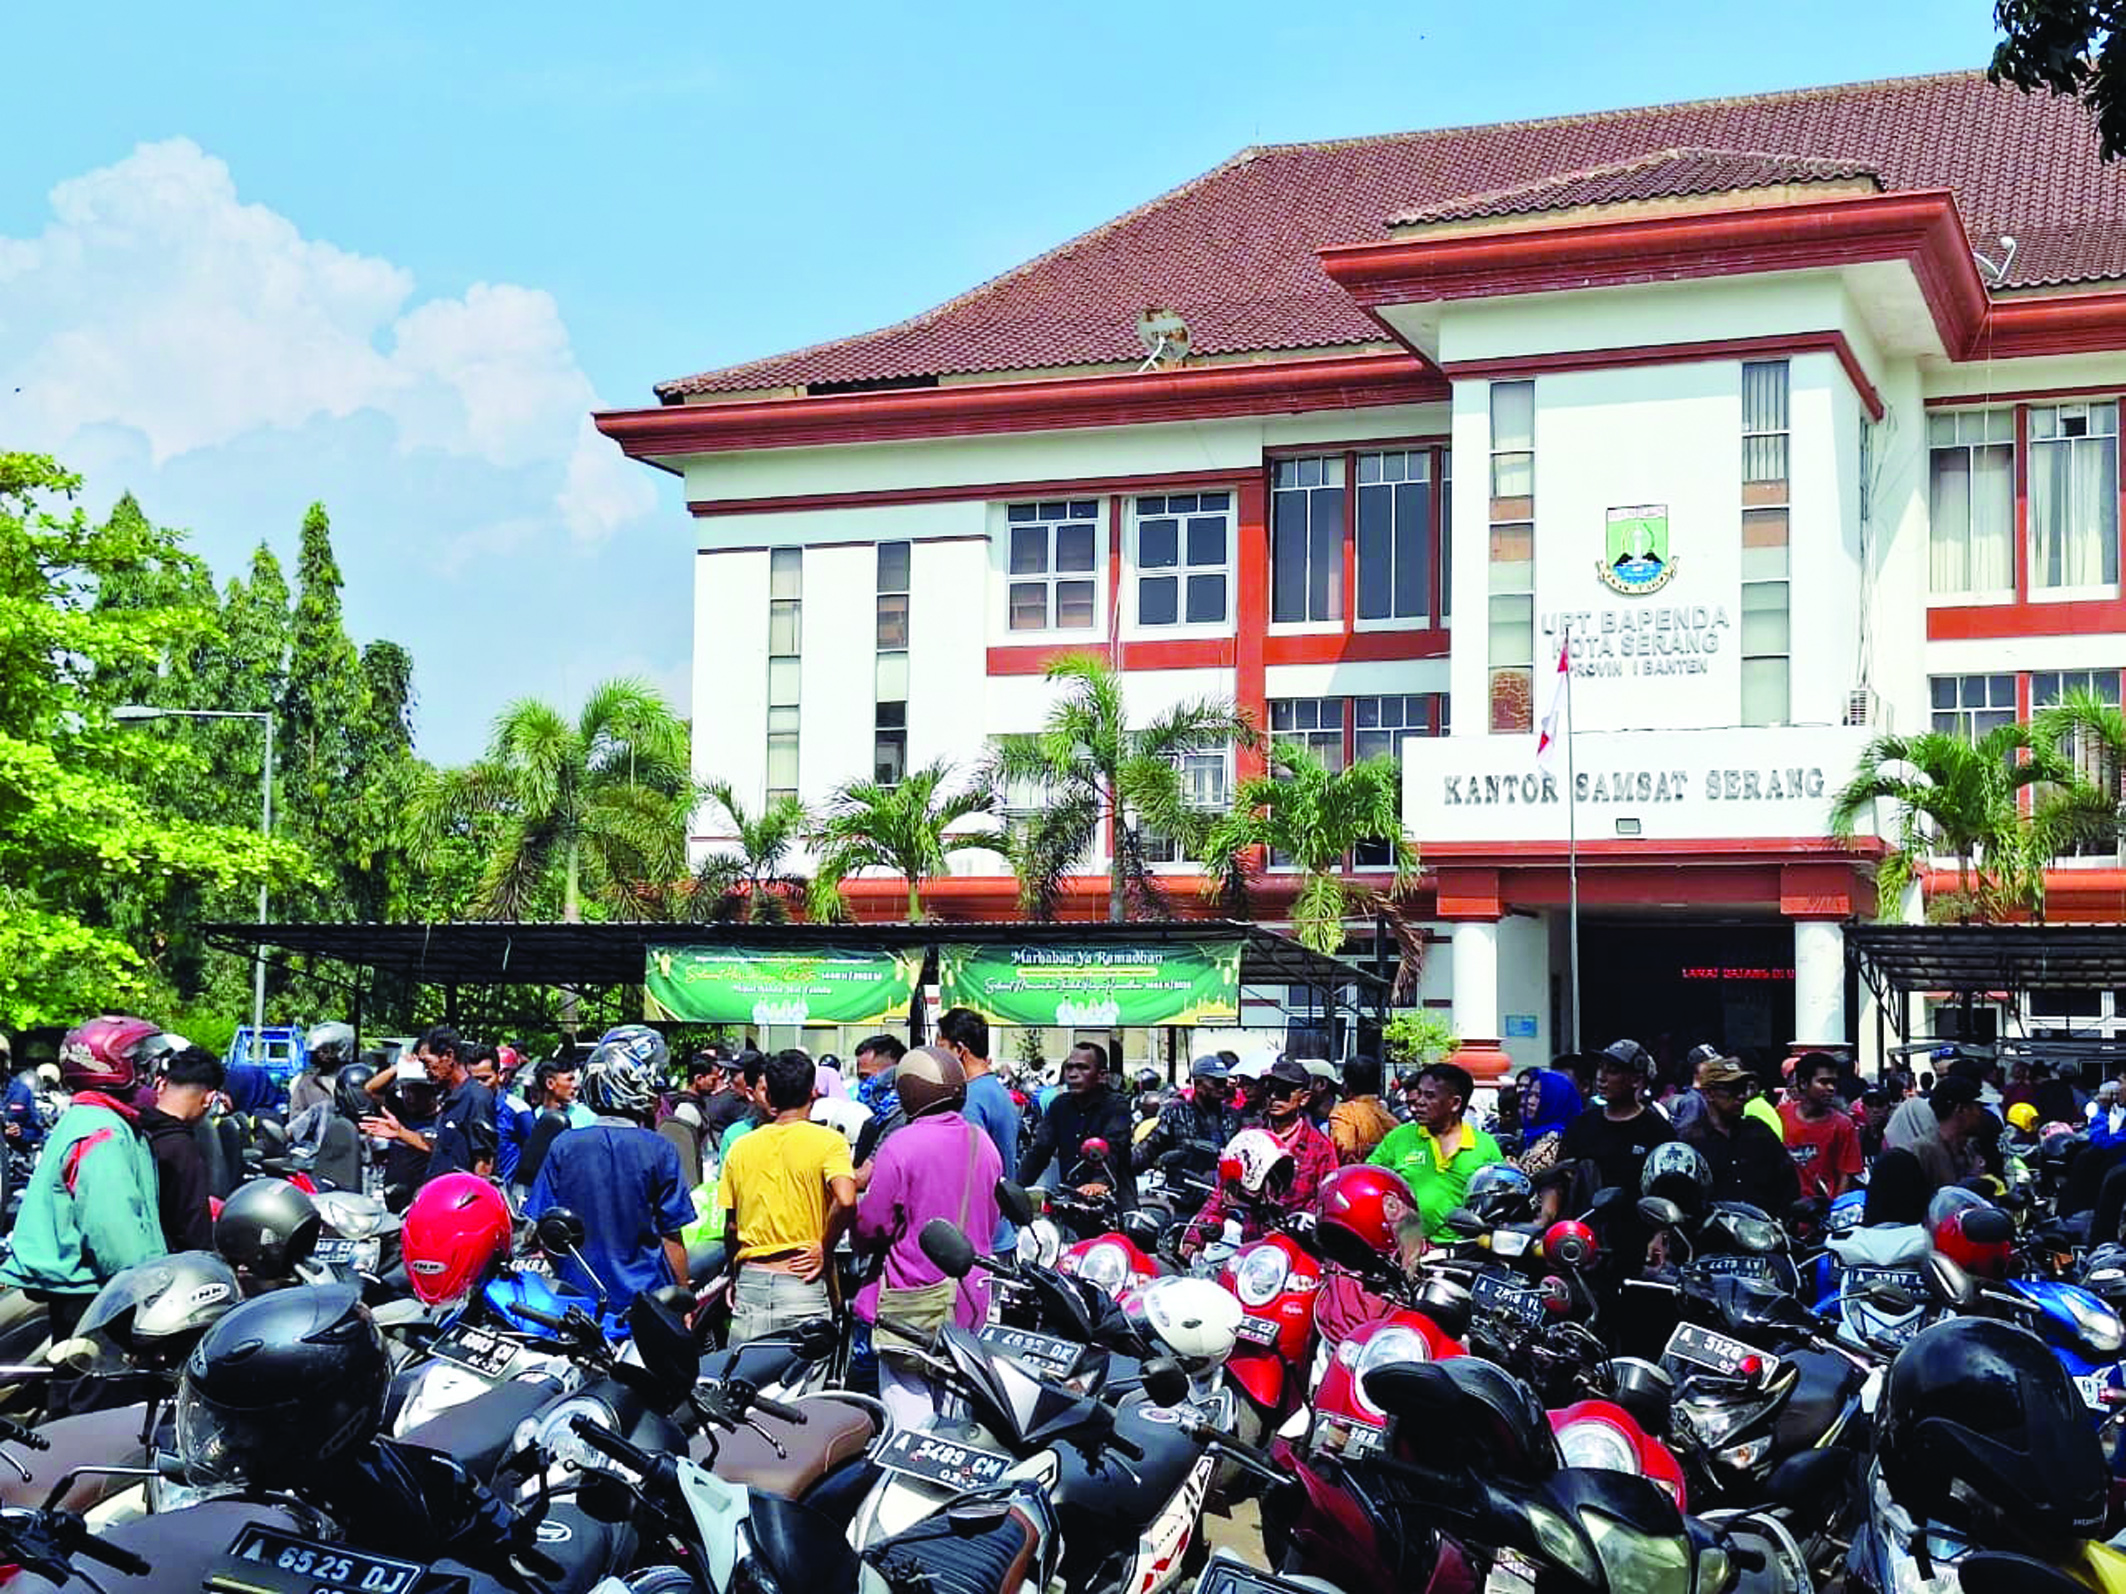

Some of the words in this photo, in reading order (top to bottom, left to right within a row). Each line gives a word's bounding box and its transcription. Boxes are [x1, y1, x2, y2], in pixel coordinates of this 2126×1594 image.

[1541, 611, 1592, 635] UPT
[1601, 606, 1730, 634] BAPENDA
[1621, 631, 1720, 657] SERANG
[1643, 658, 1709, 676] BANTEN
[1443, 774, 1559, 805] KANTOR
[1574, 771, 1688, 802] SAMSAT
[1705, 768, 1825, 801] SERANG
[1078, 951, 1092, 967] Ya
[1096, 950, 1164, 967] Ramadhan
[1679, 1328, 1692, 1343] A
[894, 1433, 911, 1452] A
[242, 1538, 265, 1562] A
[277, 1546, 354, 1582] 6525
[360, 1565, 406, 1593] DJ
